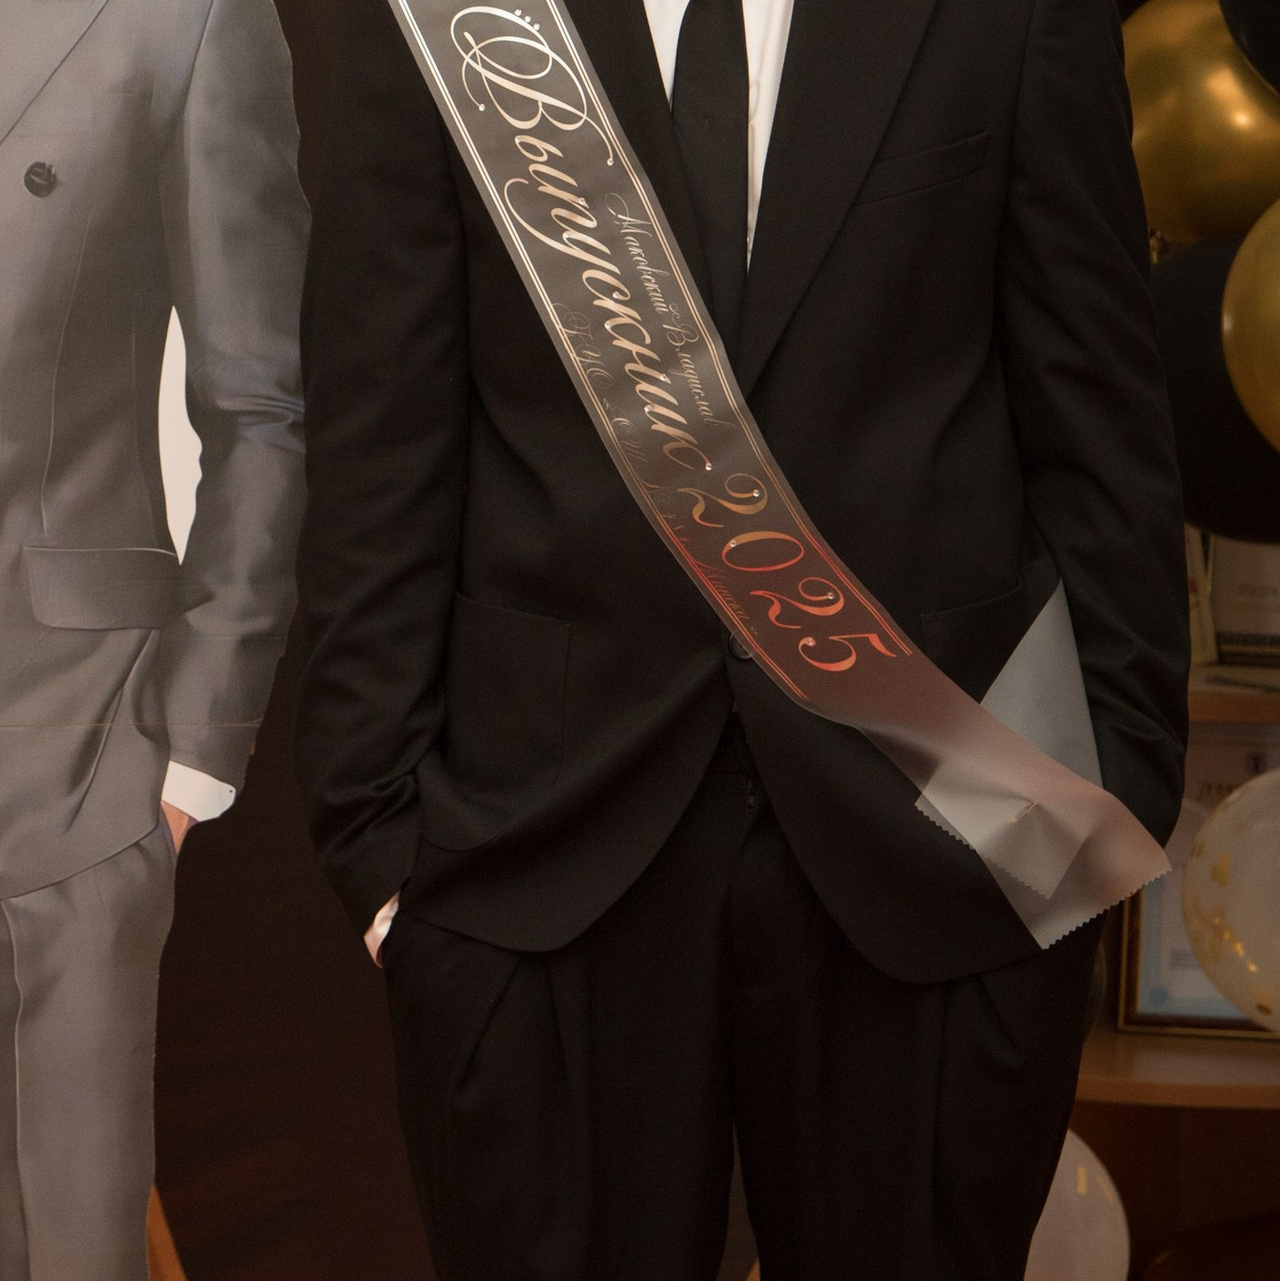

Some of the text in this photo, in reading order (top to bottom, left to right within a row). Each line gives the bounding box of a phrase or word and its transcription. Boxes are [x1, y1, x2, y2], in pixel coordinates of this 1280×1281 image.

[450, 6, 897, 674] Выпускник 2025
[663, 302, 736, 427] Владислав
